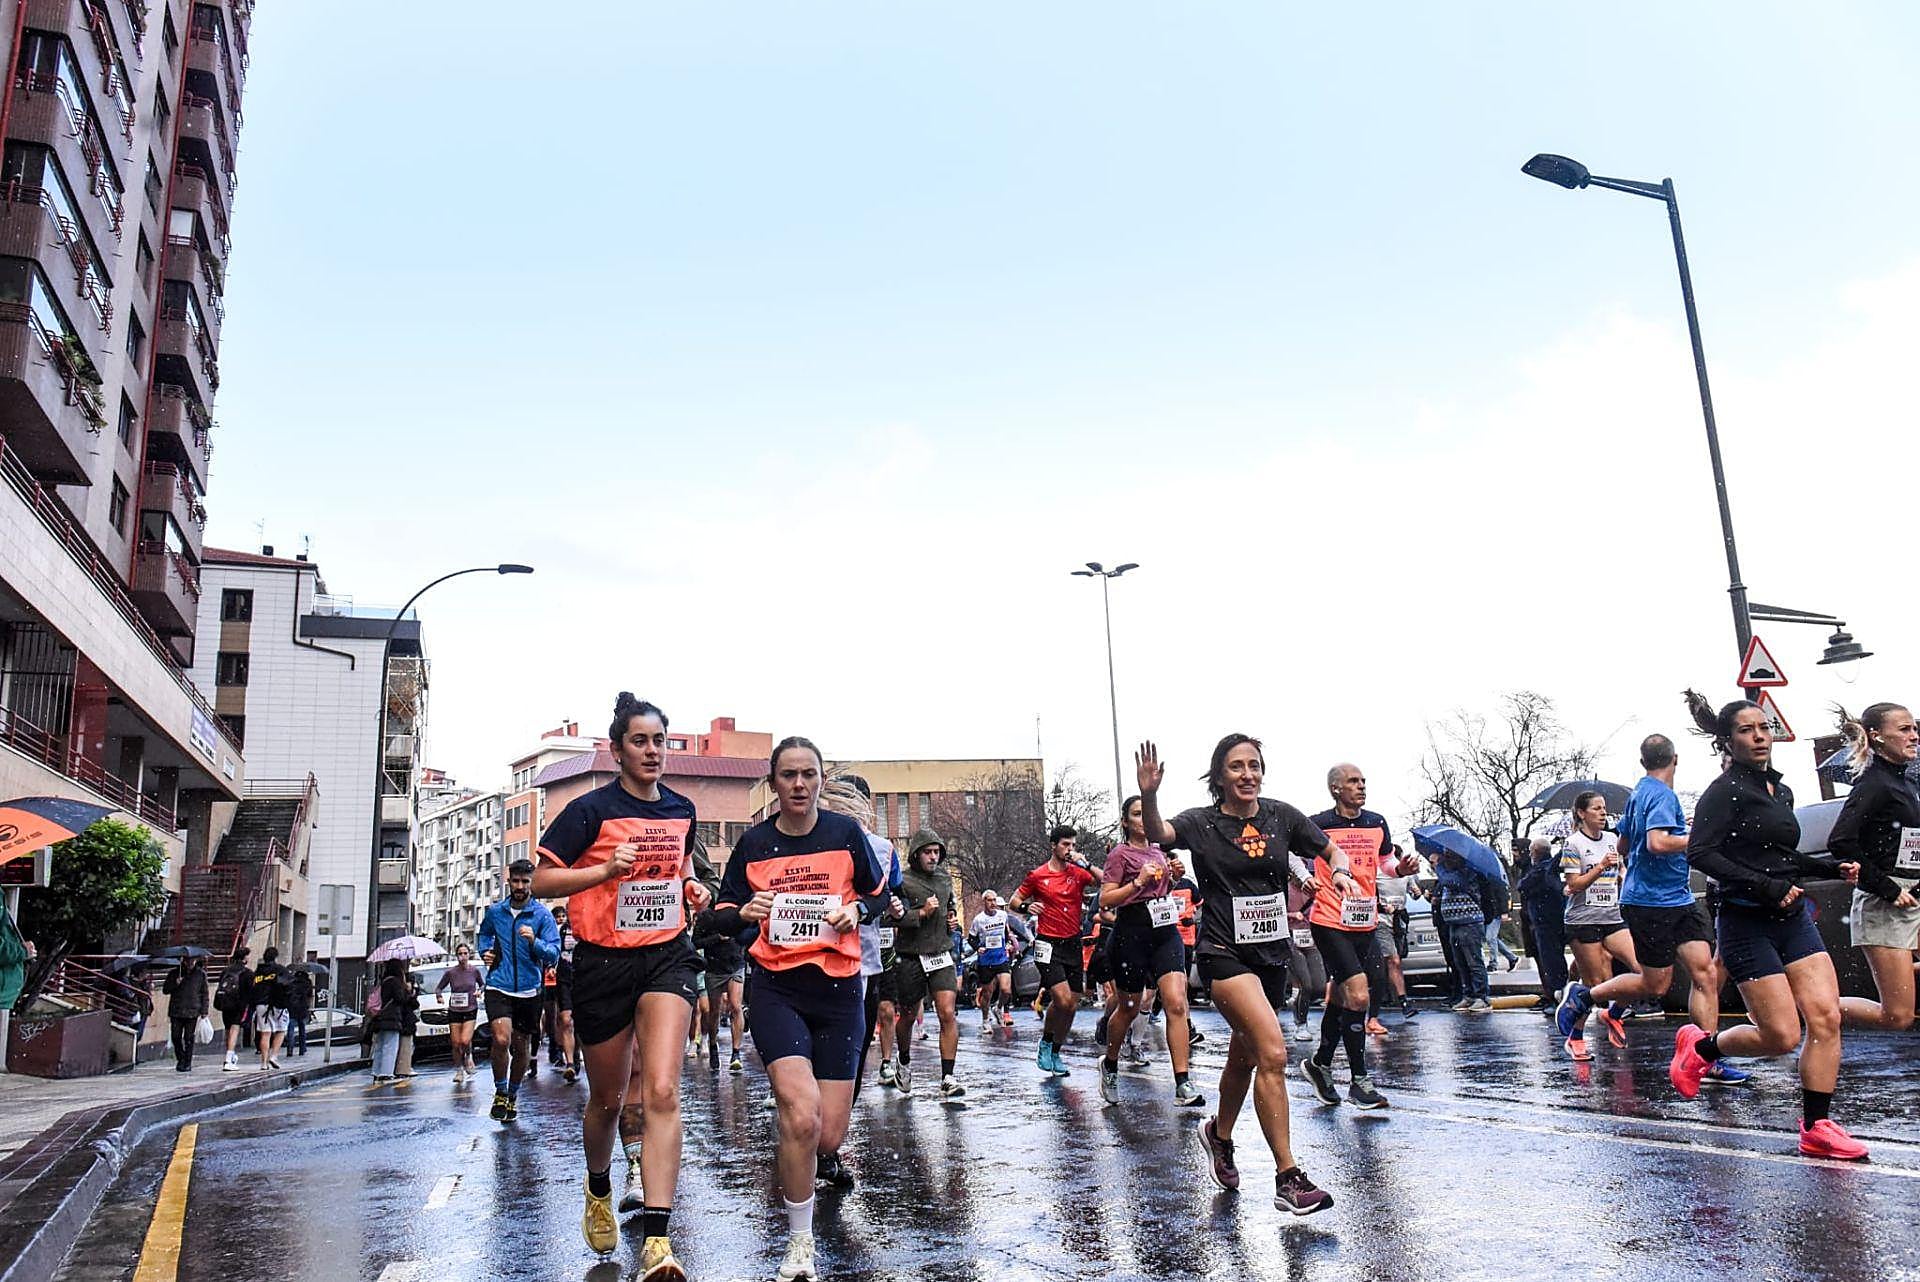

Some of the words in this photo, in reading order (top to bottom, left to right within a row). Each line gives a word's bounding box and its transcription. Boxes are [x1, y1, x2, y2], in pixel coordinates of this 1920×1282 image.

[0, 831, 42, 852] ESIS
[784, 866, 811, 876] XXXVII
[789, 882, 830, 892] INTERNACIONAL
[1254, 898, 1277, 906] CORREO
[636, 908, 665, 922] 2413
[791, 922, 820, 937] 2411
[1252, 919, 1278, 934] 2480
